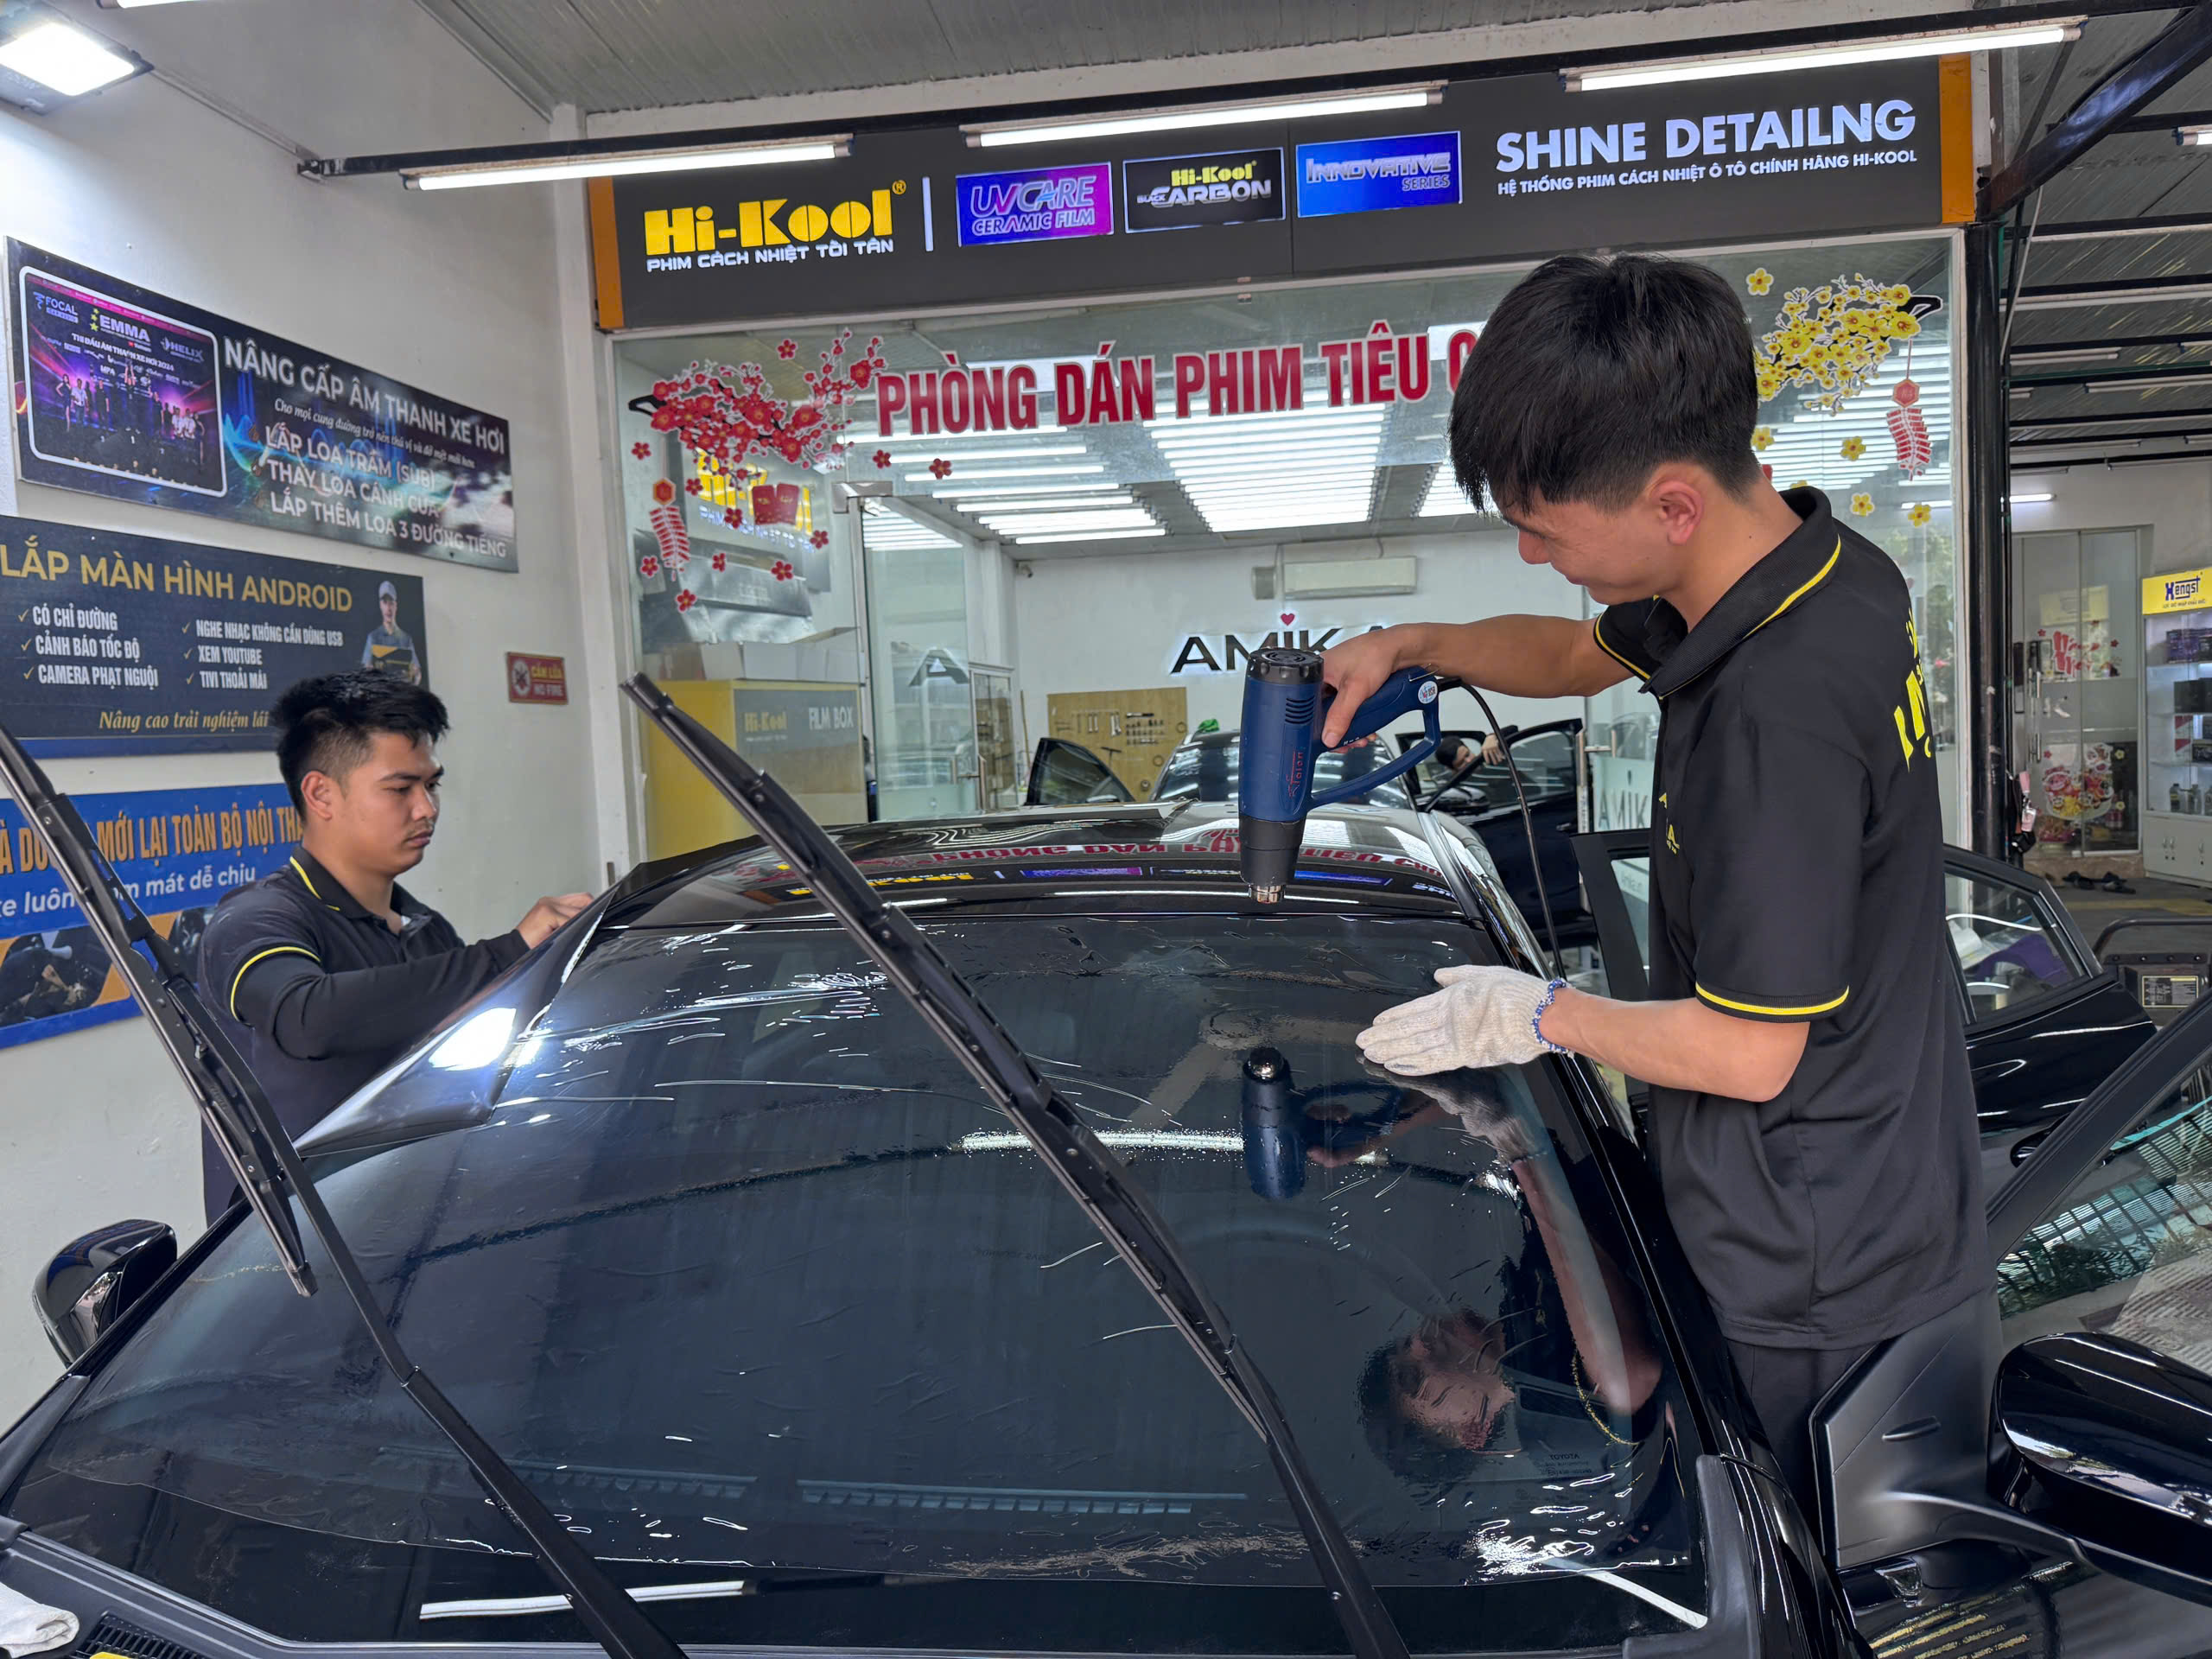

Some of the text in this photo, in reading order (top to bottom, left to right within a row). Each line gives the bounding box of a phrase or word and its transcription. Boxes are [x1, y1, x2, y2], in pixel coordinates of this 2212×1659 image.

[1496, 99, 1916, 172] SHINE DETAILNG
[1171, 162, 1254, 188] Hi-Kool
[1402, 175, 1450, 192] SERIES
[1497, 149, 1917, 197] HỆ THỐNG PHIM CÁCH NHIỆT Ô TÔ CHÍNH HÃNG HI-KOOL
[1150, 179, 1272, 208] CARBON
[972, 207, 1096, 236] CERAMIC FILM
[646, 257, 692, 272] PHIM
[697, 251, 749, 268] CÁCH
[755, 244, 810, 263] NHIỆT
[854, 237, 893, 255] TÂN
[46, 296, 78, 315] FOCAL
[99, 315, 150, 341] EMMA
[876, 351, 1038, 436] PHÒNG
[1054, 340, 1156, 427] DÁN
[1173, 344, 1304, 418] PHIM
[1319, 320, 1431, 407] TIÊU
[223, 335, 505, 454] NÂNG CẤP ÂM THANH XE HƠI
[275, 397, 293, 415] Cho
[295, 406, 312, 422] mọi
[313, 412, 334, 429] cung
[307, 437, 344, 466] LOA
[397, 461, 435, 490] (SUB)
[267, 459, 316, 488] THAY
[321, 471, 357, 499] LOA
[270, 486, 308, 518] LẮP
[311, 499, 361, 530] THÊM
[365, 518, 397, 537] LOA
[399, 520, 408, 538] 3
[0, 535, 353, 612] LẮP MÀN HÌNH ANDROID
[32, 602, 118, 631] CÓ CHỈ ĐƯỜNG
[35, 629, 141, 664] CẢNH BÁO TỐC ĐỘ
[196, 619, 223, 639] NGHE
[224, 622, 251, 643] NHẠC
[251, 622, 283, 643] KHÔNG
[327, 630, 344, 647] USB
[198, 645, 263, 665] XEM YOUTUBE
[38, 664, 159, 690] CAMERA PHẠT NGUỘI
[200, 671, 219, 688] TIVI
[249, 670, 268, 690] MÁI
[99, 709, 270, 733] Nâng cao trải nghiệm lái
[809, 707, 830, 730] FILM
[834, 706, 854, 729] BOX
[96, 810, 134, 862] MỚI
[139, 816, 168, 867] LẠI
[172, 804, 217, 855] TOÀN
[220, 802, 243, 857] BỘ
[246, 800, 275, 855] NỘI
[0, 895, 16, 918] e
[24, 887, 75, 914] luôn
[146, 872, 185, 897] mát
[189, 864, 213, 890] dễ
[218, 863, 257, 887] chịu
